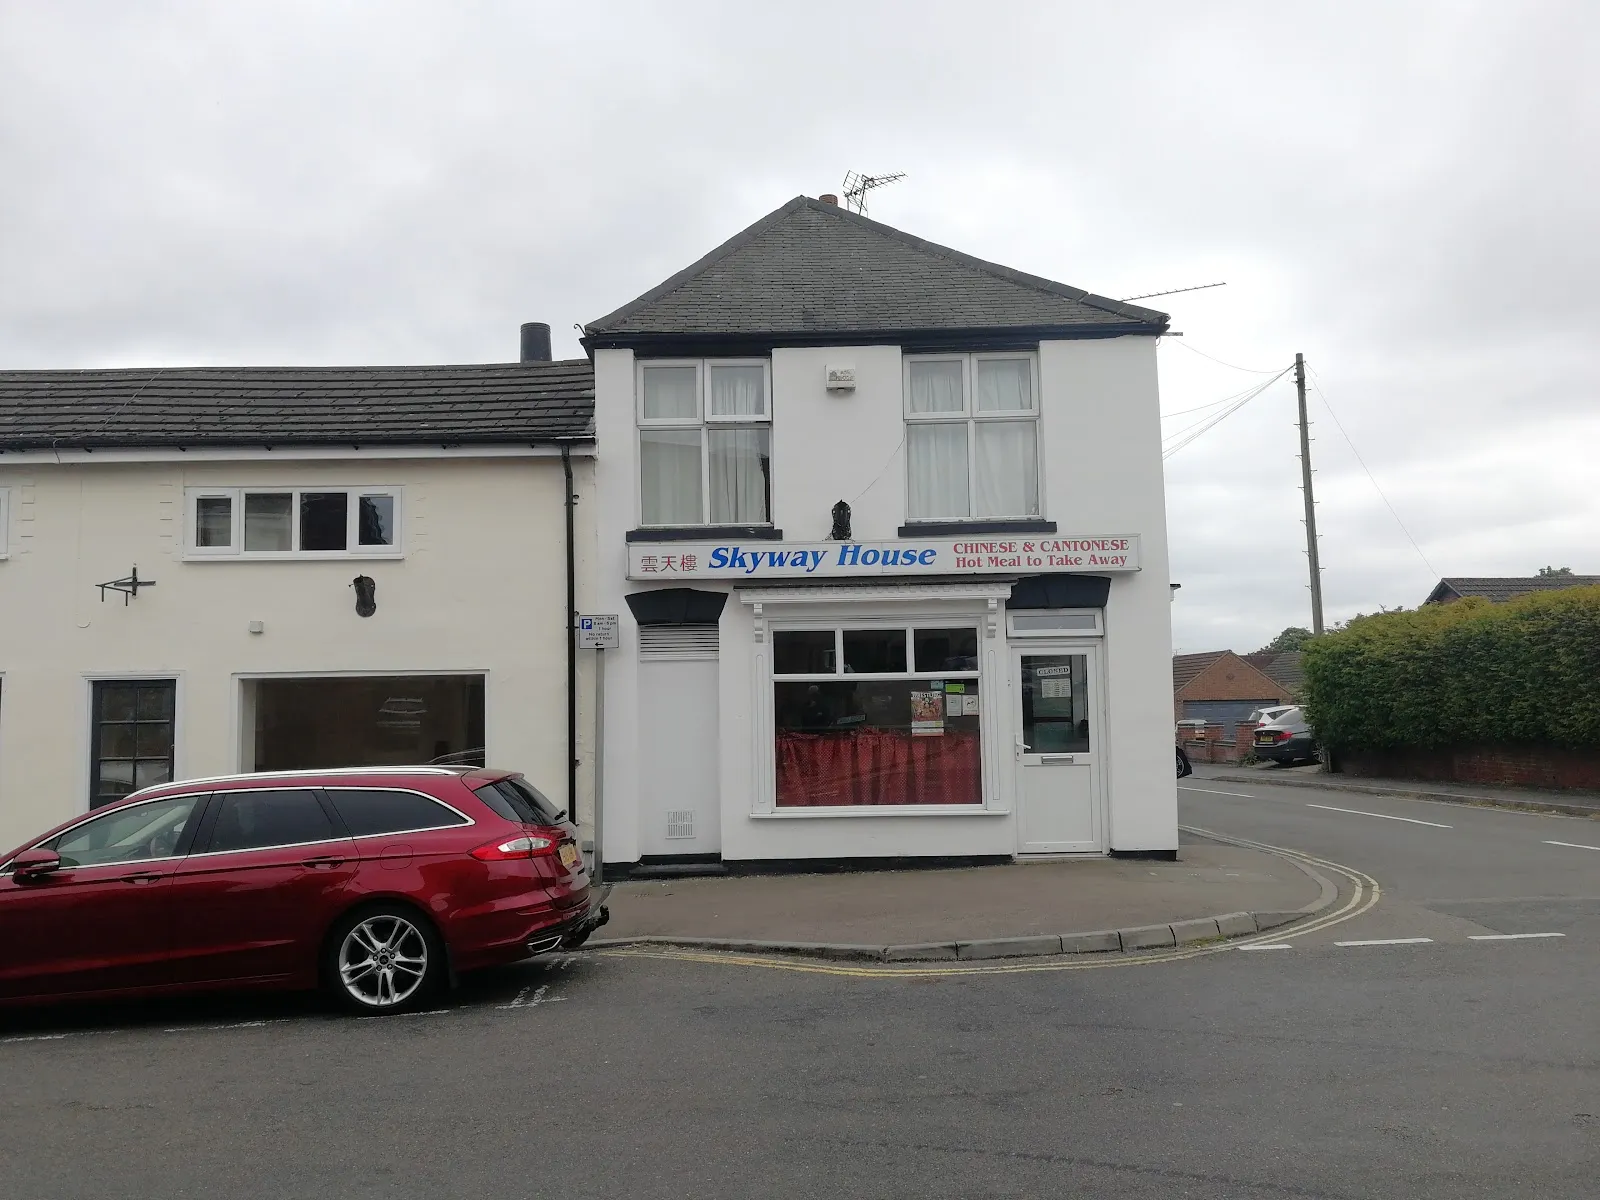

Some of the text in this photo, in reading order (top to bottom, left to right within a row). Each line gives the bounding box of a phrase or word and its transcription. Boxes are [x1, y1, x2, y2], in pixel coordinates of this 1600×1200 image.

[953, 539, 1130, 554] CHINESE & CANTONESE
[640, 554, 698, 573] 雲天樓
[708, 544, 937, 574] Skyway House
[955, 553, 1128, 568] Hot Meal to Take Away
[583, 619, 592, 629] P
